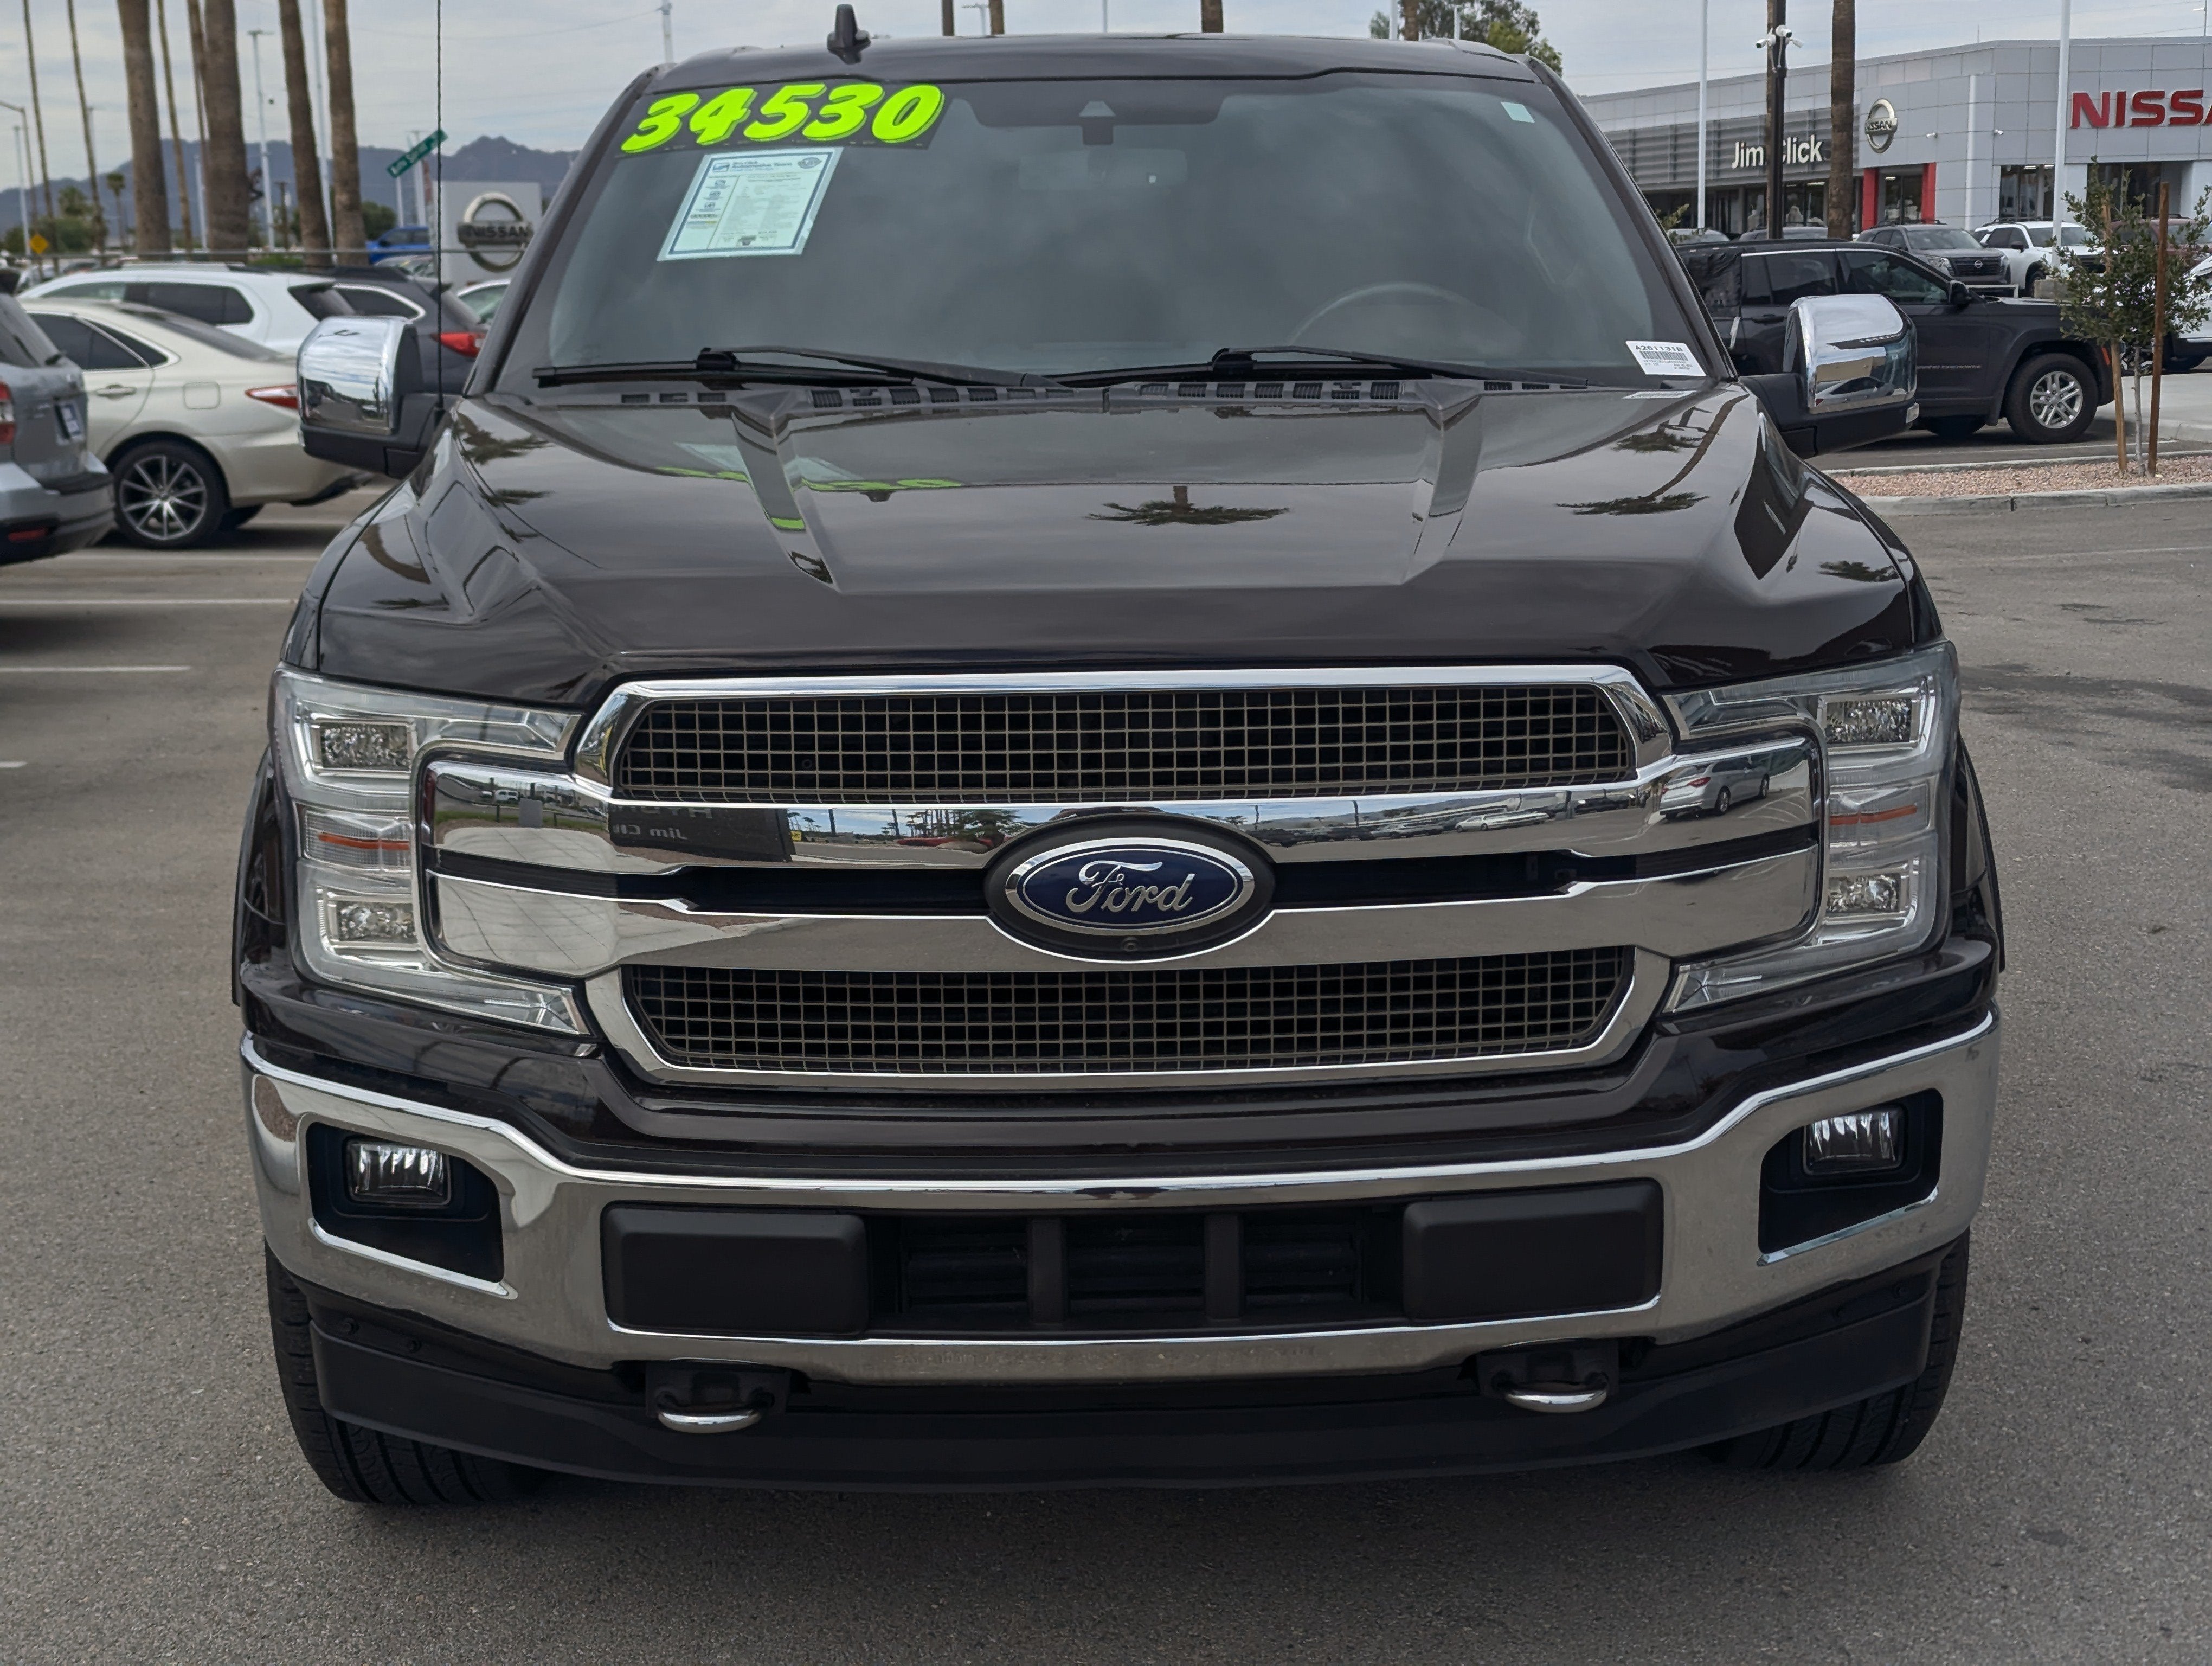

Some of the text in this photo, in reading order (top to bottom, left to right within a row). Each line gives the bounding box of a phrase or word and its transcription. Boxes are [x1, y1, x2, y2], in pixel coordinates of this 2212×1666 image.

[621, 84, 945, 153] 34530
[2070, 88, 2212, 129] NISS
[1732, 142, 1764, 169] Jim
[467, 226, 529, 238] NISSAN
[1066, 860, 1195, 912] Ford
